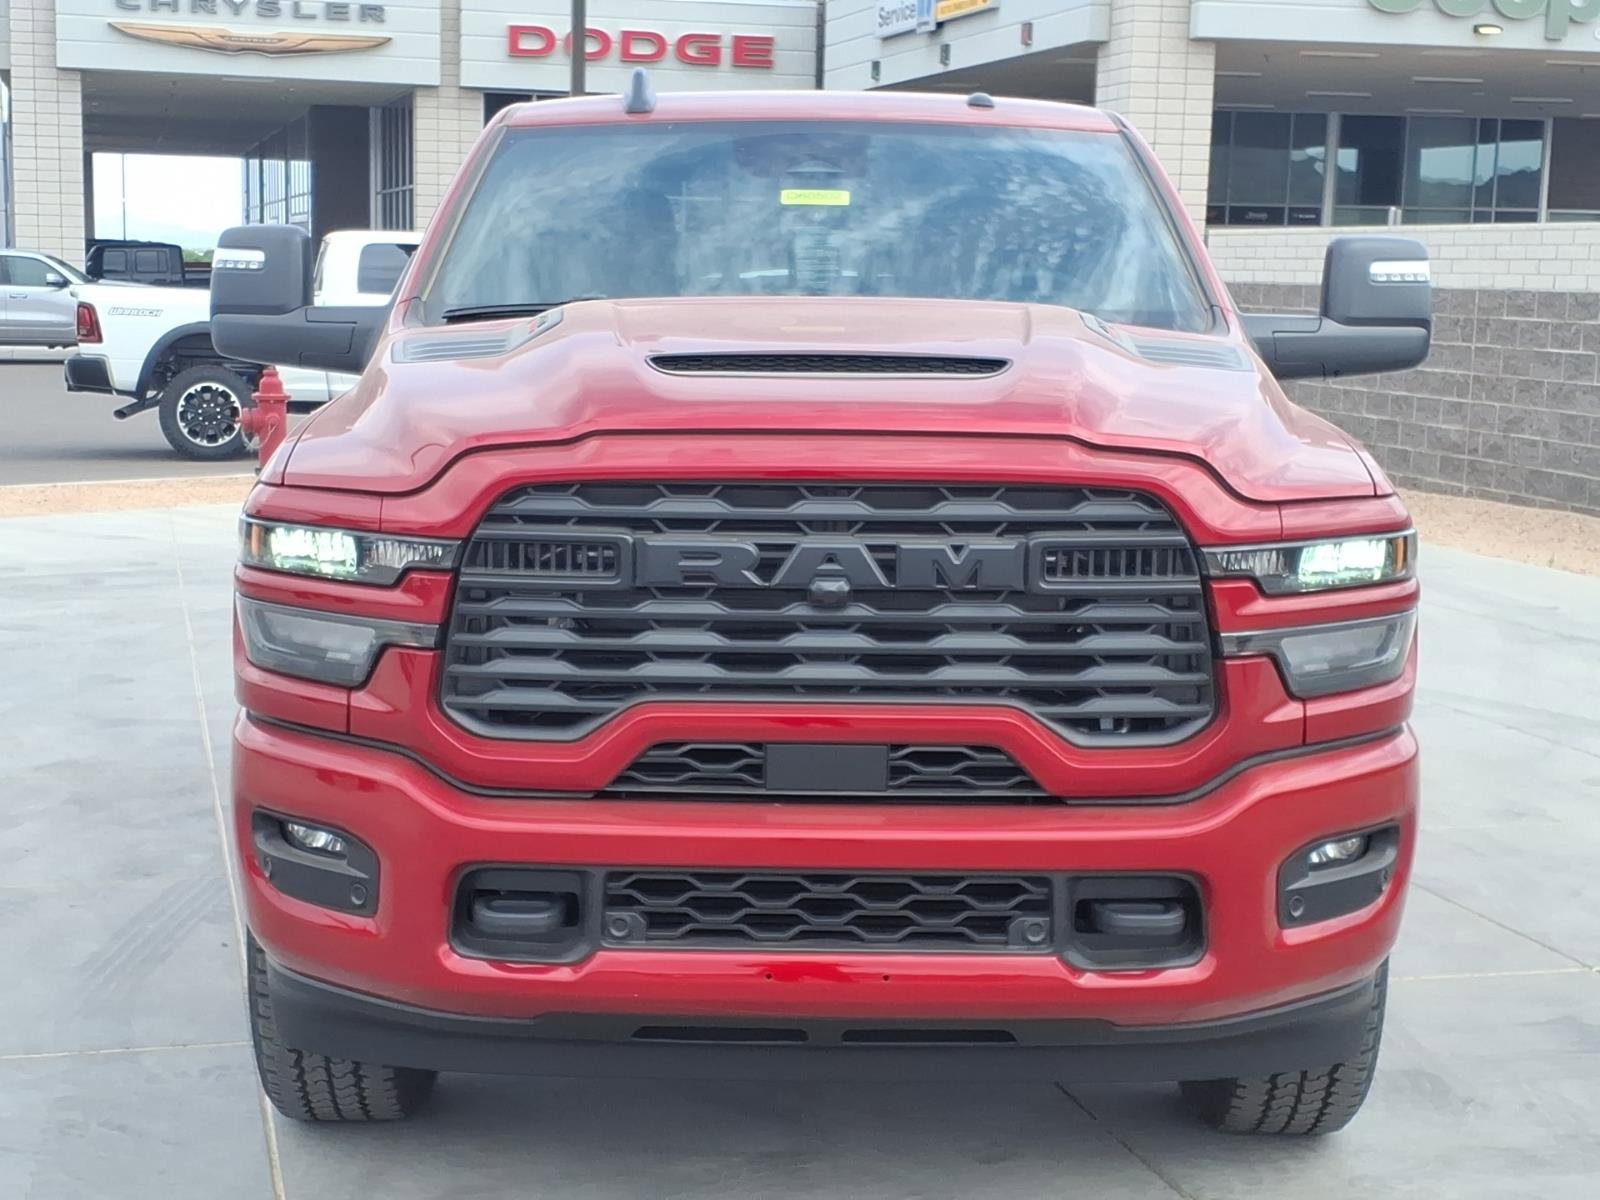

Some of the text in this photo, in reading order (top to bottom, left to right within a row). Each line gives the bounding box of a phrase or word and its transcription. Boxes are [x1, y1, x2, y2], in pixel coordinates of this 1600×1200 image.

[115, 0, 386, 23] CHRYSLER
[878, 3, 916, 28] Service
[507, 25, 775, 68] DODGE
[637, 539, 1026, 590] RAM
